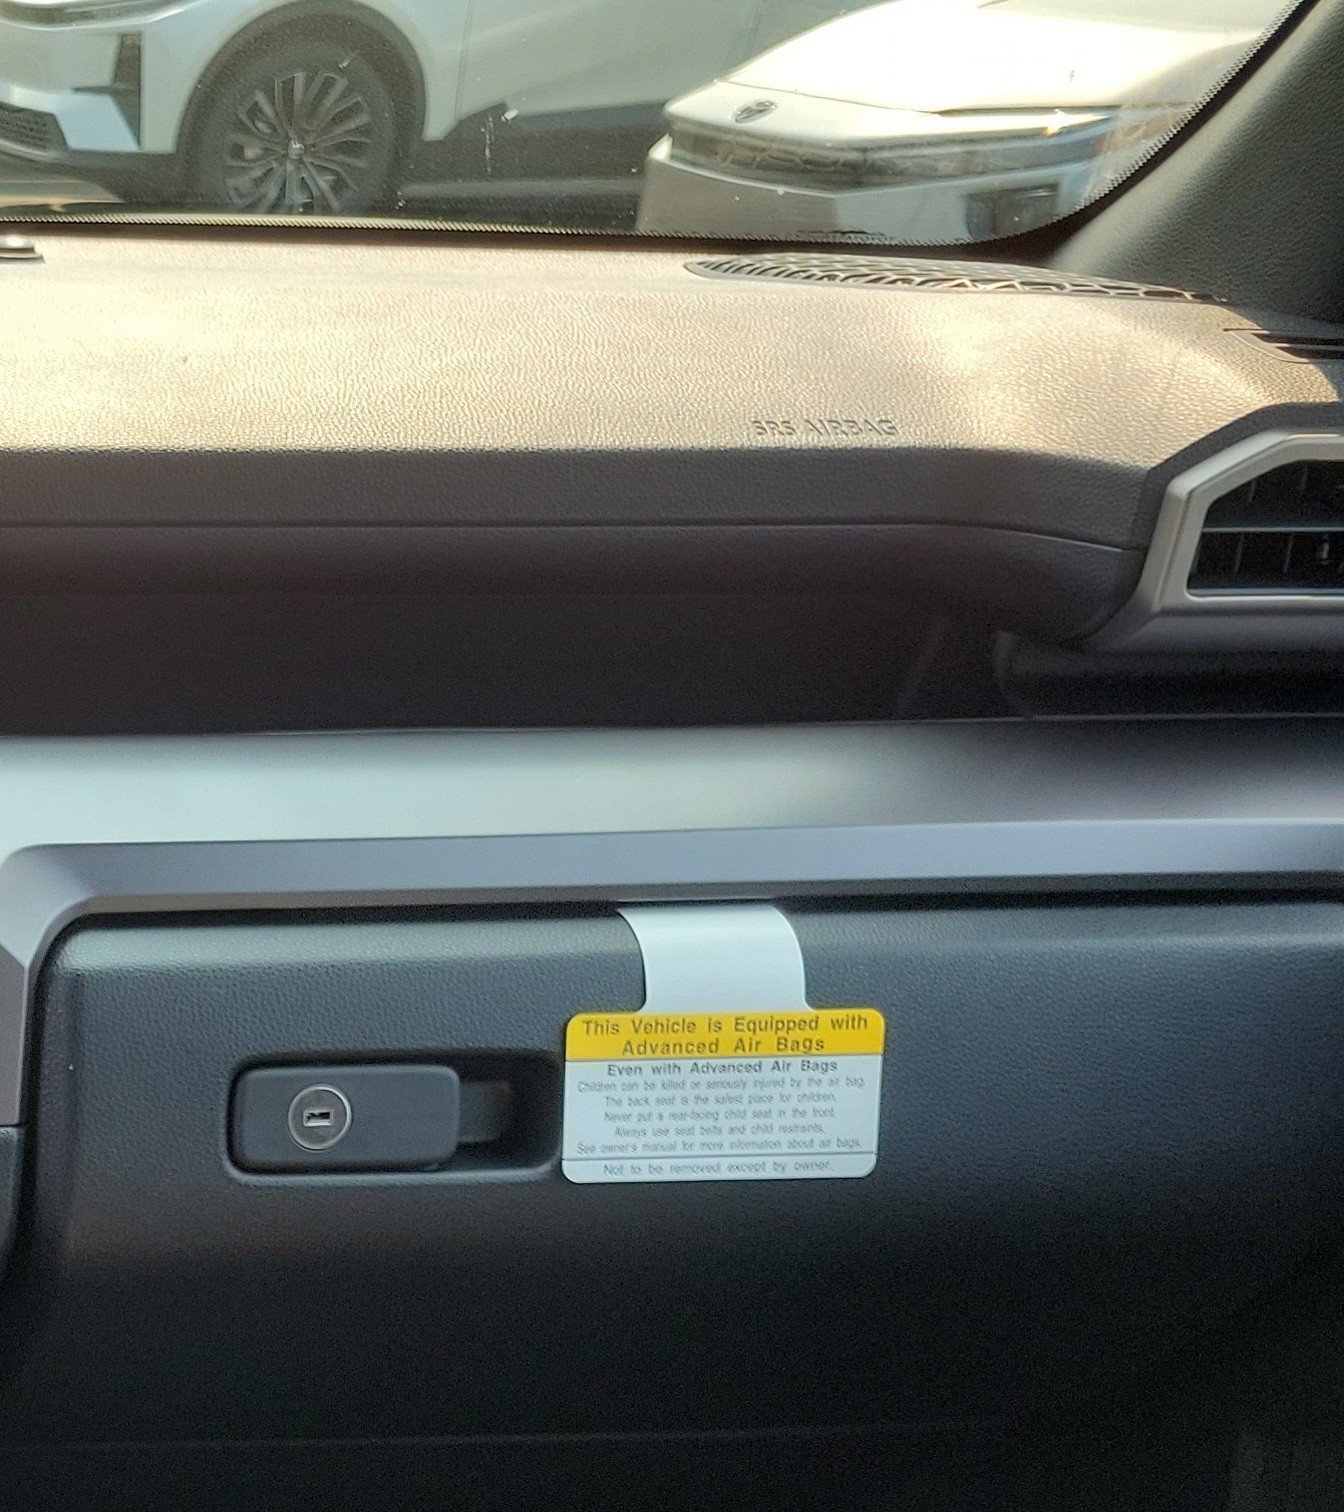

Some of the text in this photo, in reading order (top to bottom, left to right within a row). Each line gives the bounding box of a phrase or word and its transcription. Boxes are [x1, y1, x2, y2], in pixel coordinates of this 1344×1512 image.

[752, 419, 901, 437] SRS AIRBAG
[583, 1015, 868, 1036] This Vehicle is Equipped with
[623, 1036, 825, 1056] Advanced Air Bags
[608, 1060, 838, 1076] Even with Advanced Air Bags
[578, 1081, 616, 1093] Children
[603, 1165, 624, 1176] Not
[630, 1164, 642, 1174] to
[648, 1164, 663, 1174] be
[670, 1163, 721, 1174] removed
[727, 1162, 766, 1173] except
[773, 1162, 787, 1173] by
